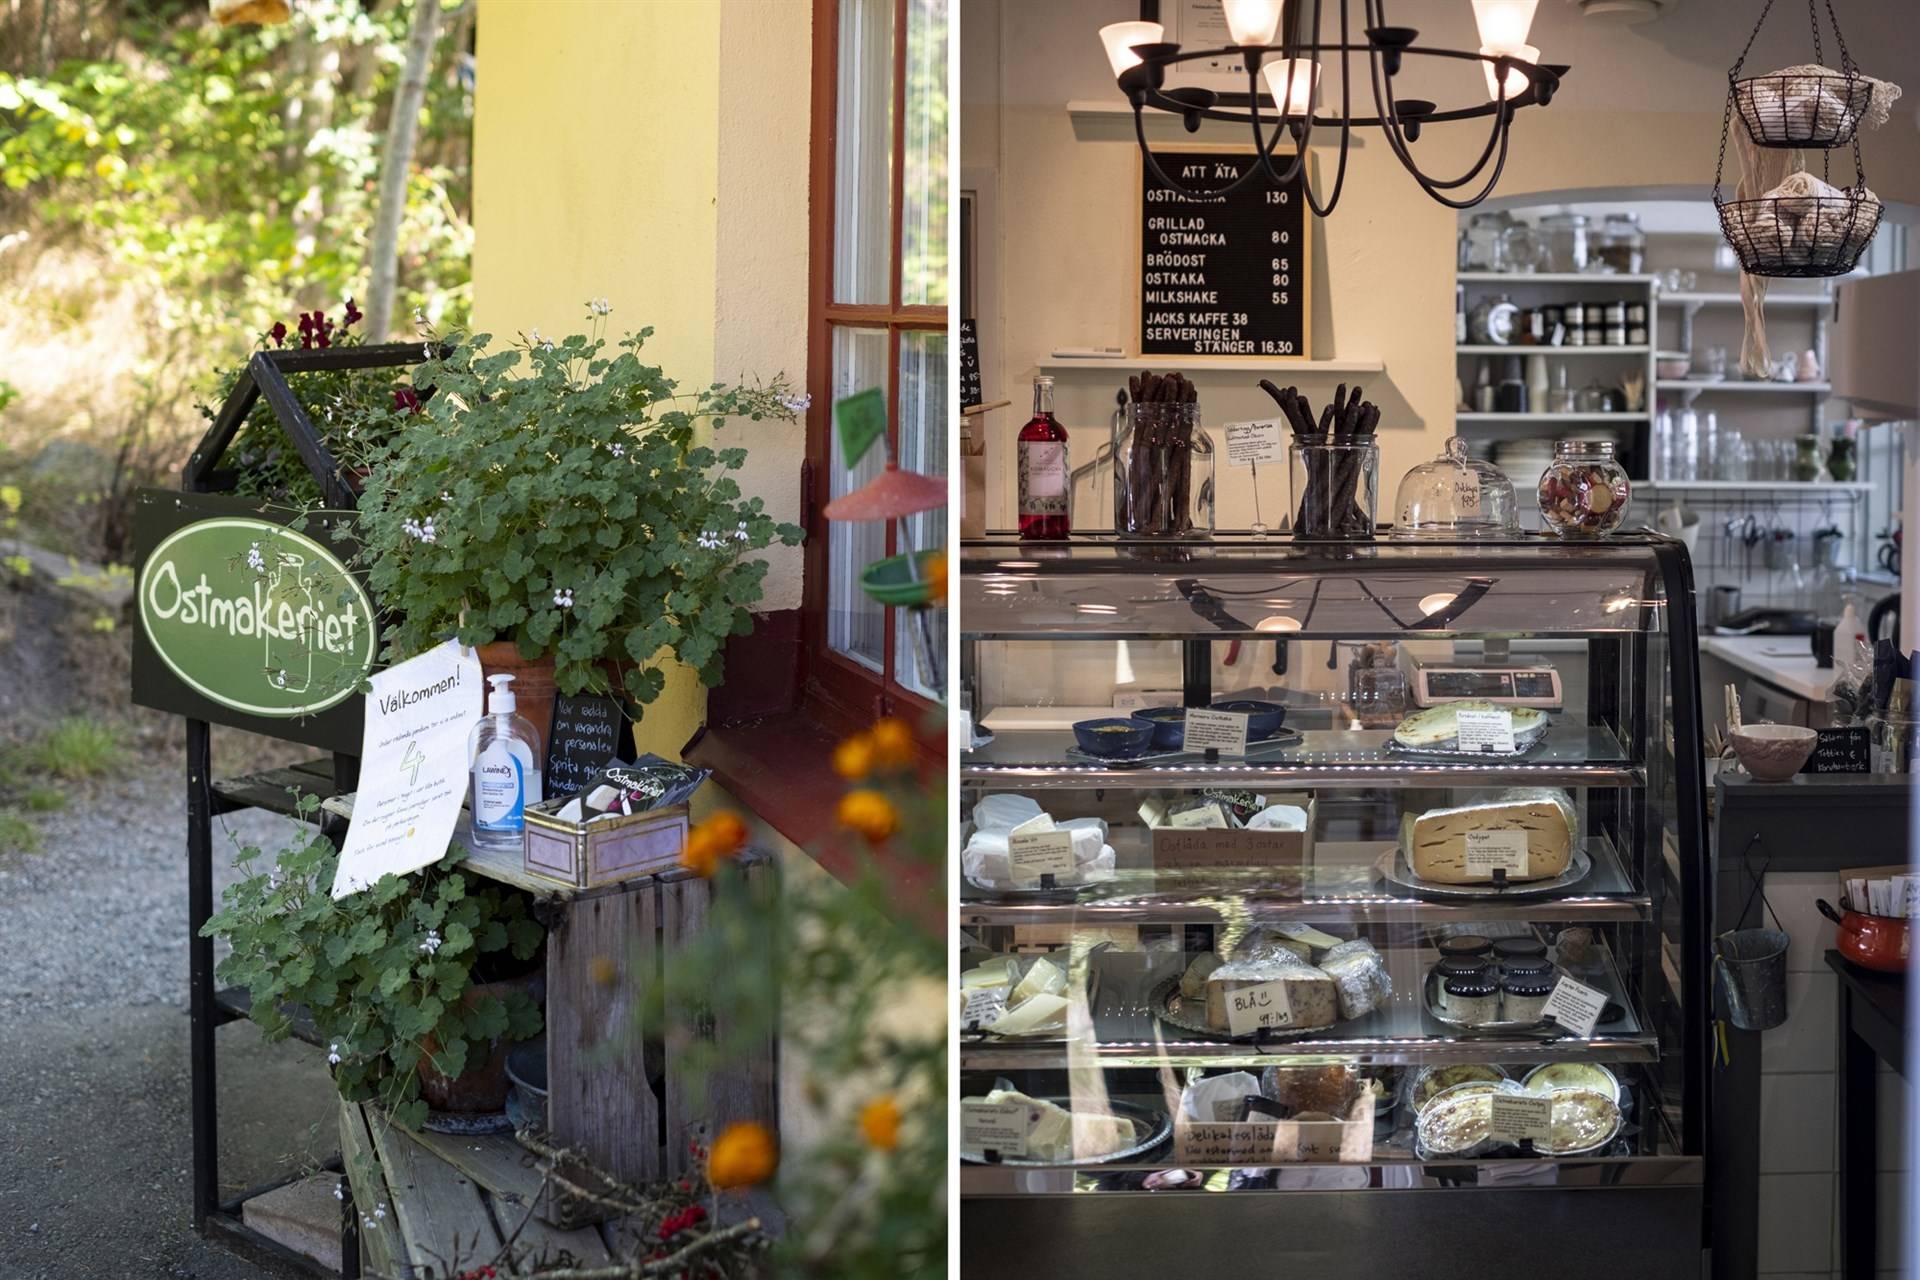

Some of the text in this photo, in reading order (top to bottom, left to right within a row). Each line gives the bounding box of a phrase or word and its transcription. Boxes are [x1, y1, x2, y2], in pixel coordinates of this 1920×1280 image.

[1182, 163, 1238, 178] ATT ÄTA
[1266, 191, 1288, 204] 130
[1148, 218, 1205, 230] GRILLAD
[1160, 232, 1288, 246] OSTMACKA 80
[1147, 251, 1288, 271] BRÖDOST 65
[1146, 272, 1205, 285] OSTKAKA
[1146, 292, 1288, 305] MILKSHAKE 55
[1146, 313, 1248, 325] JACKS KAFFE 38
[1146, 328, 1240, 341] SERVERINGEN
[1194, 340, 1293, 354] STÄNGER 16.30
[150, 561, 358, 655] Ostmakeriet
[380, 664, 460, 716] Välkommen!
[399, 741, 426, 786] 4
[1216, 839, 1237, 849] med
[1235, 991, 1256, 1011] BLÅ
